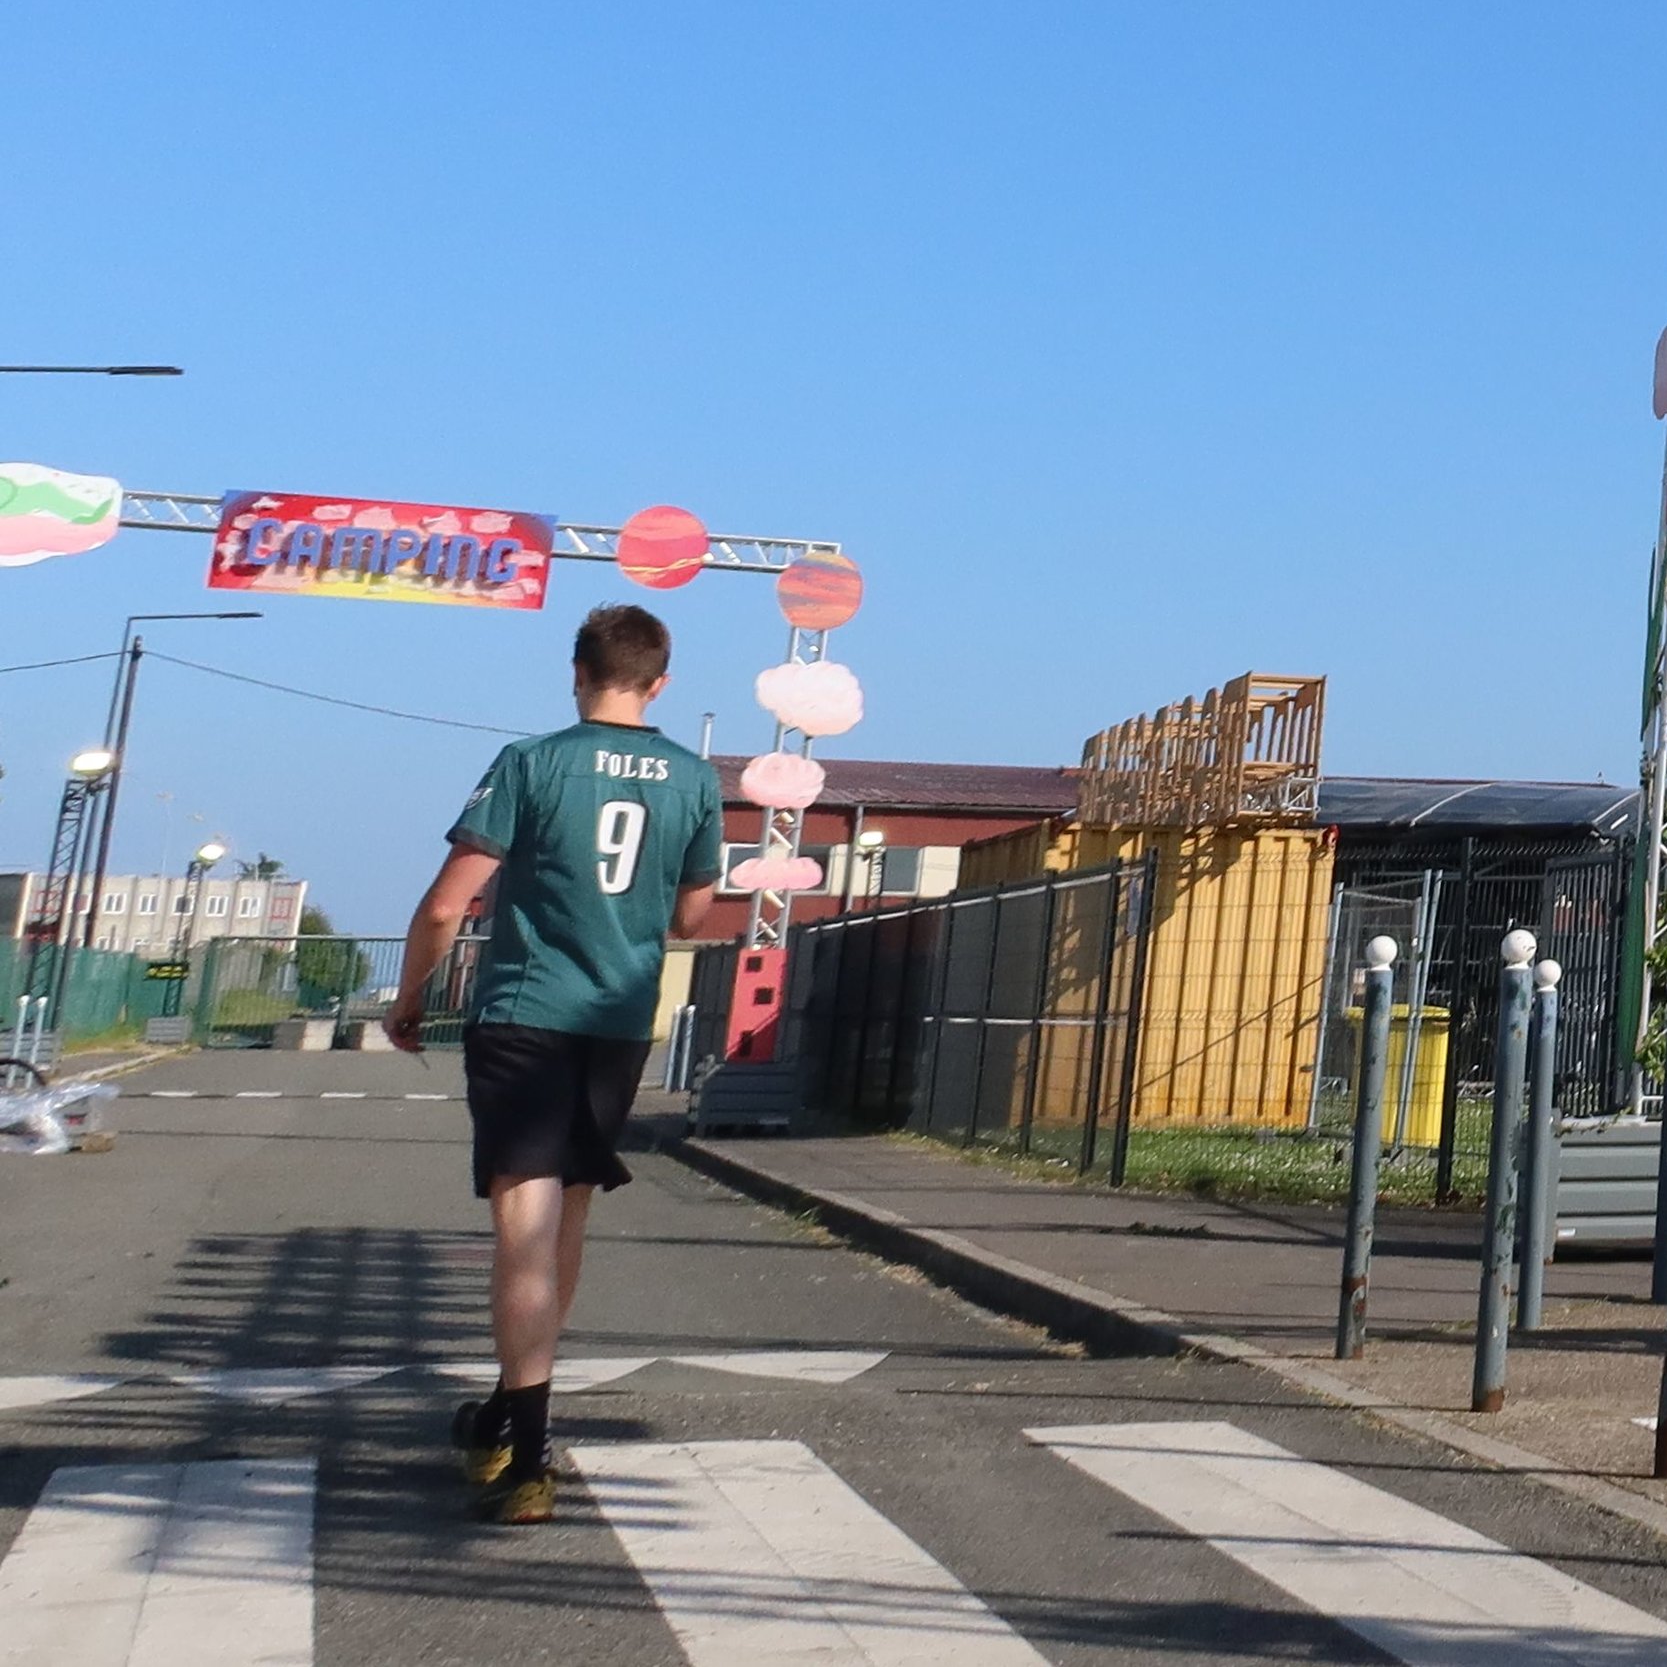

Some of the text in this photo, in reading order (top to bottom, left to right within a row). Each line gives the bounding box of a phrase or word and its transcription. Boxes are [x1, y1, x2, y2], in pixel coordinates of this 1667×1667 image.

[247, 518, 522, 583] CAMPING
[594, 749, 669, 781] FOLES
[597, 799, 648, 895] 9
